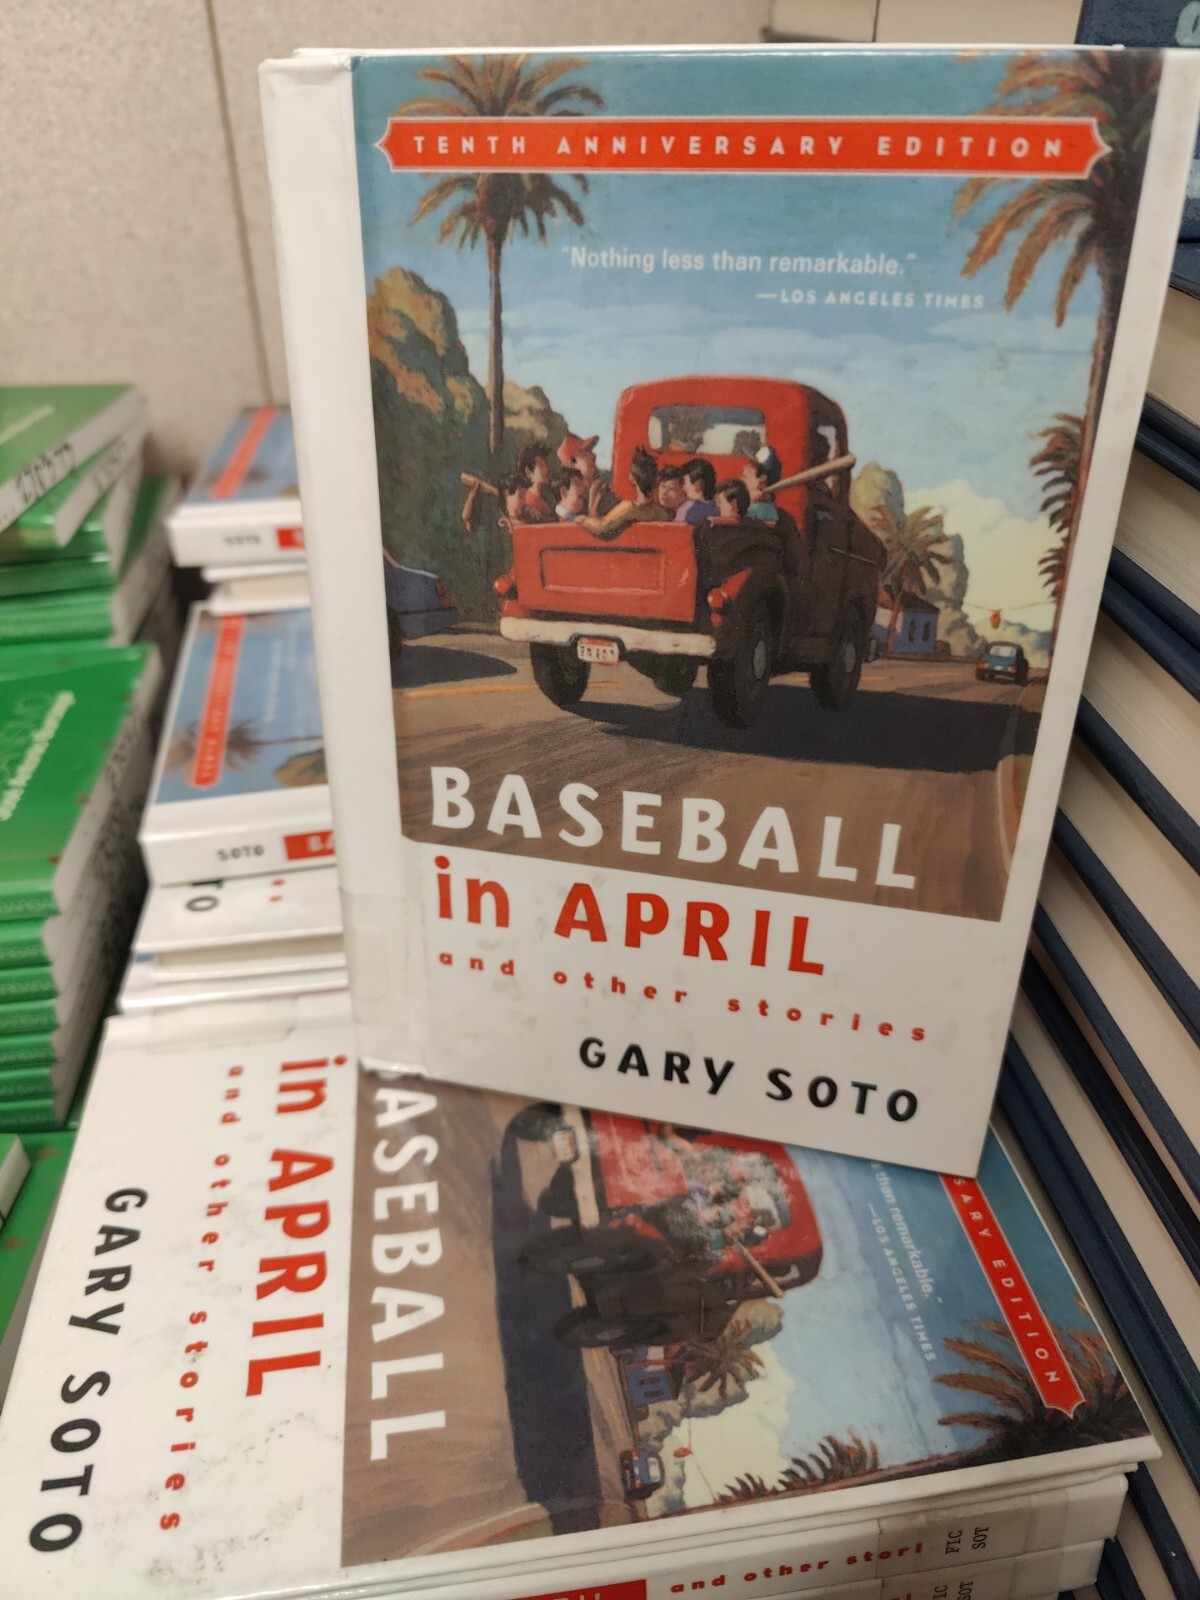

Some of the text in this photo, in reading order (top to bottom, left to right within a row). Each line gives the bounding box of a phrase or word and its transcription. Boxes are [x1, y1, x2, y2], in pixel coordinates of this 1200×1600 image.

[413, 135, 1063, 158] TENTH ANNIVERSARY EDITION
[661, 248, 705, 271] less
[712, 250, 762, 273] than
[825, 291, 915, 308] ANGELES
[923, 293, 984, 310] TIMES
[216, 844, 265, 862] SOTO
[429, 765, 916, 890] BASEBALL
[434, 855, 825, 976] in APRIL
[438, 949, 926, 1043] and other stories
[578, 1036, 919, 1122] GARY SOTO
[245, 1054, 349, 1398] in APRIL
[874, 1170, 897, 1205] than
[159, 1065, 244, 1532] and other stories
[369, 1085, 447, 1461] ASEBALL
[883, 1247, 918, 1312] ANGELES
[912, 1314, 937, 1362] TIMES
[992, 1257, 1061, 1384] EDITION
[28, 1186, 149, 1553] GARY SOTO
[669, 1574, 727, 1594] and
[743, 1559, 830, 1583] other
[944, 1529, 963, 1556] FIC
[971, 1526, 990, 1550] SOT
[932, 1584, 949, 1600] IC
